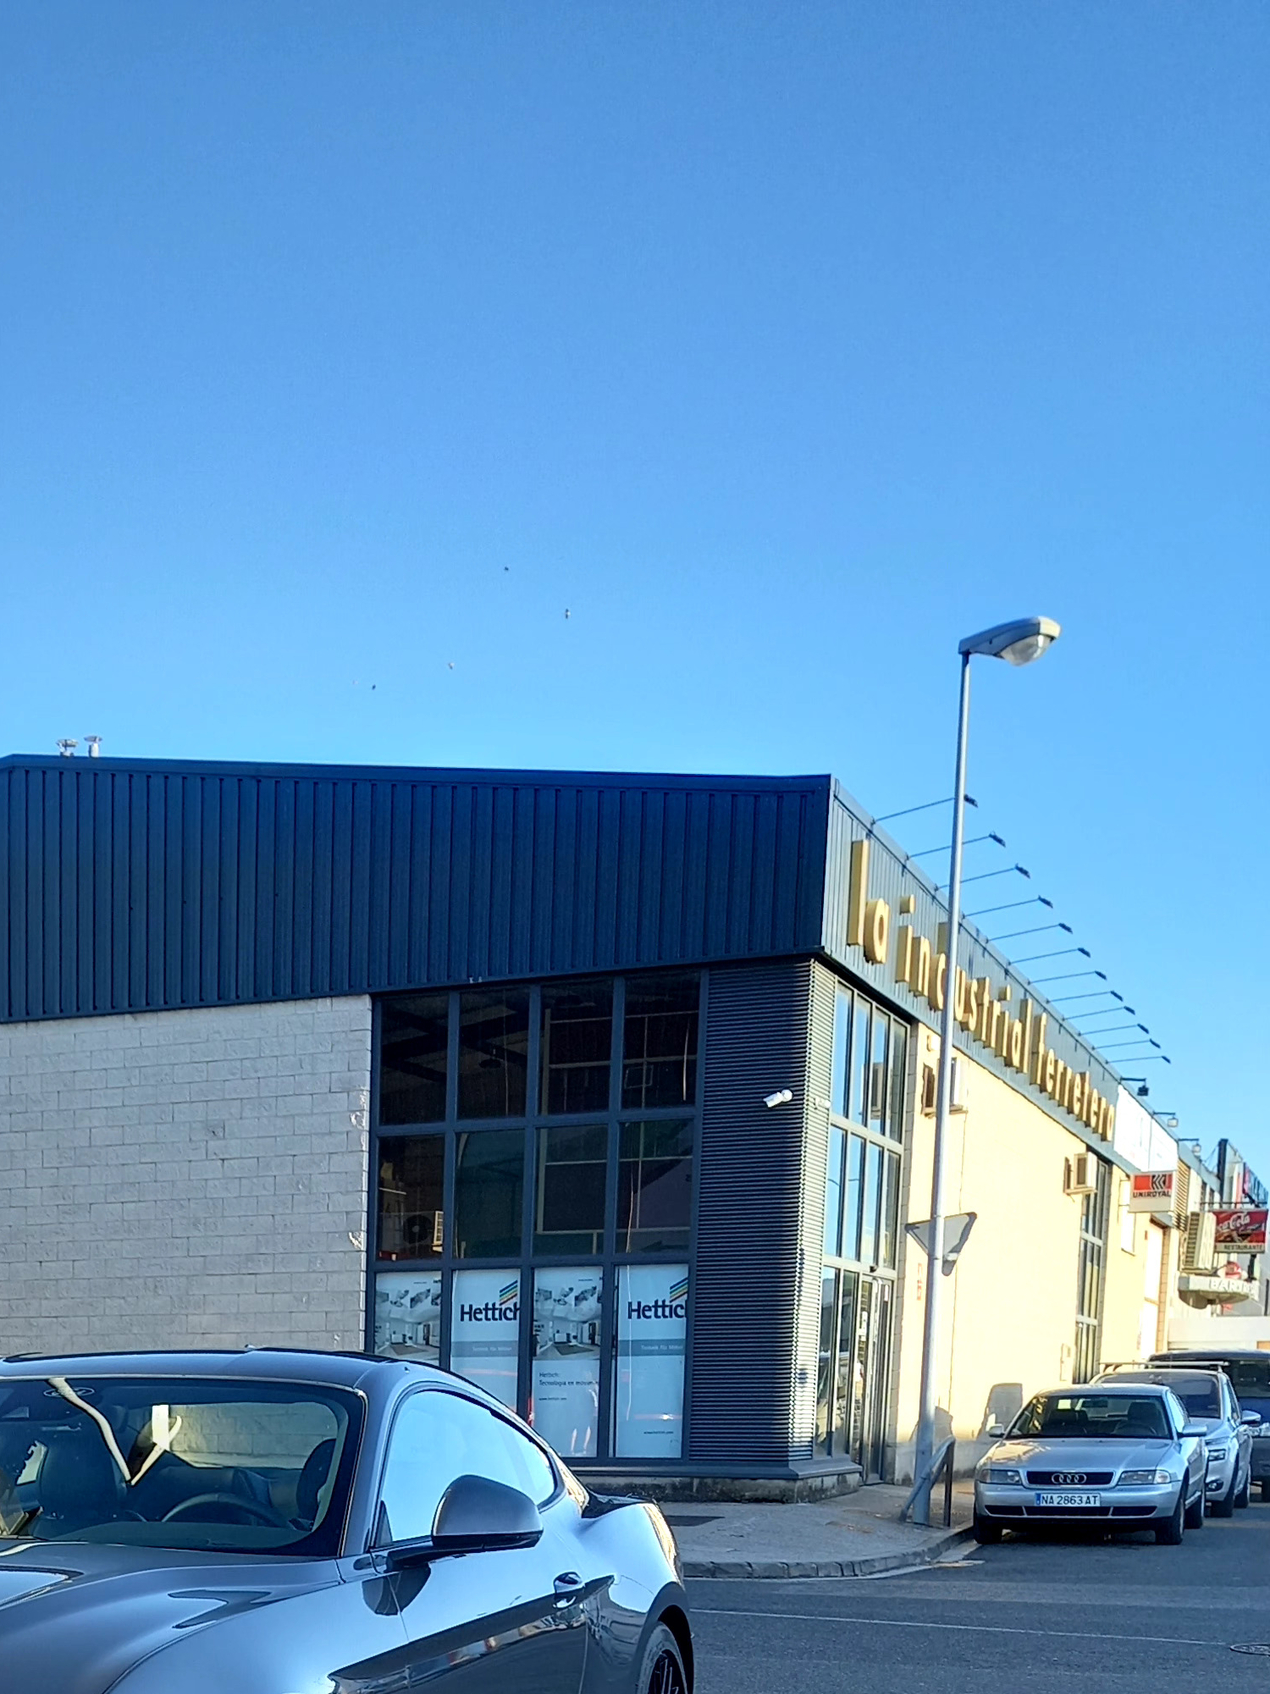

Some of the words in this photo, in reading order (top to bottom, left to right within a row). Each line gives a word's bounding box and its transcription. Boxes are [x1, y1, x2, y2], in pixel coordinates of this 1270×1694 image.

[847, 839, 890, 965] la
[1133, 1190, 1171, 1199] UNIROYAL
[628, 1299, 688, 1319] Hettic
[1041, 1495, 1054, 1505] NA
[1057, 1495, 1083, 1505] 2863
[1085, 1495, 1098, 1505] AT
